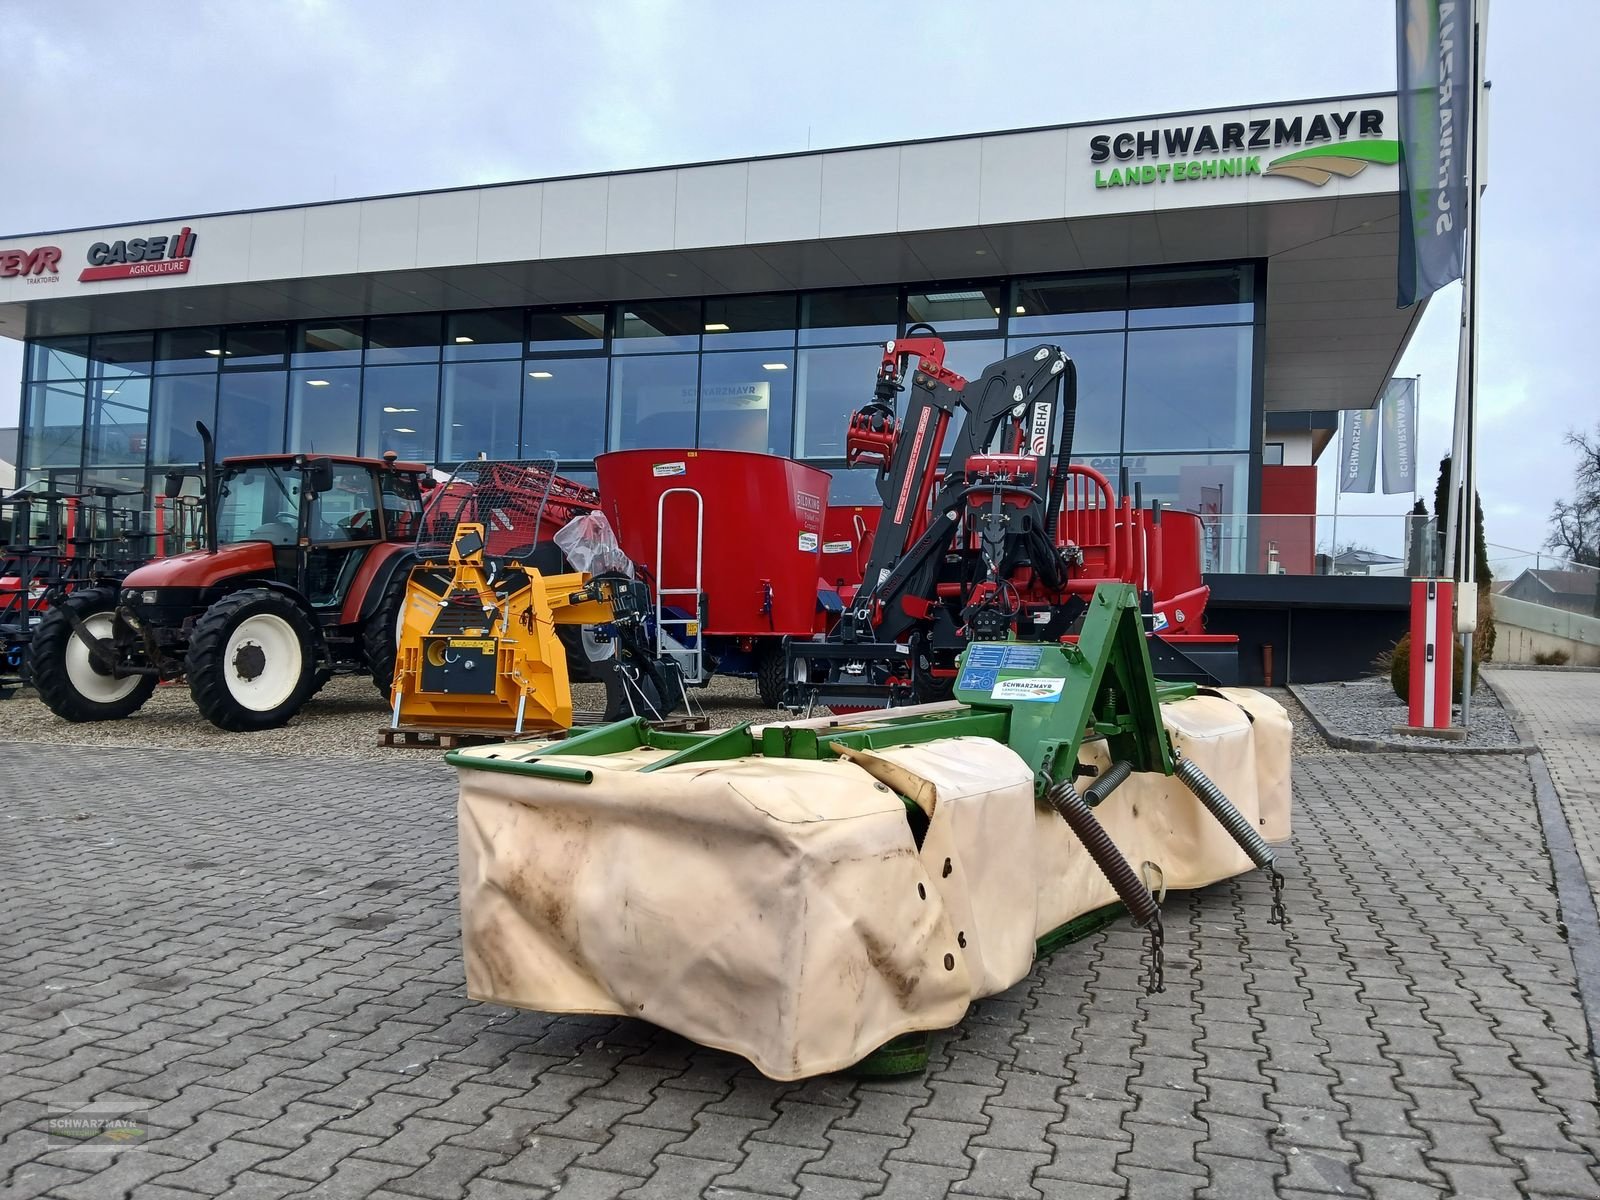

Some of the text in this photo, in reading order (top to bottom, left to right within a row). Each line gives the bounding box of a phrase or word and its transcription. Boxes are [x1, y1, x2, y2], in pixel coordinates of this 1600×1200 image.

[1089, 109, 1384, 163] SCHWARZMAYR
[1094, 155, 1262, 188] LANDTECHNIK
[0, 245, 62, 277] EYR
[86, 236, 168, 266] CASE
[26, 275, 60, 285] TRAKTOREN
[129, 262, 184, 275] AGRICULTURE
[681, 386, 756, 397] SCWARZMAYR
[1034, 403, 1049, 435] BEHA
